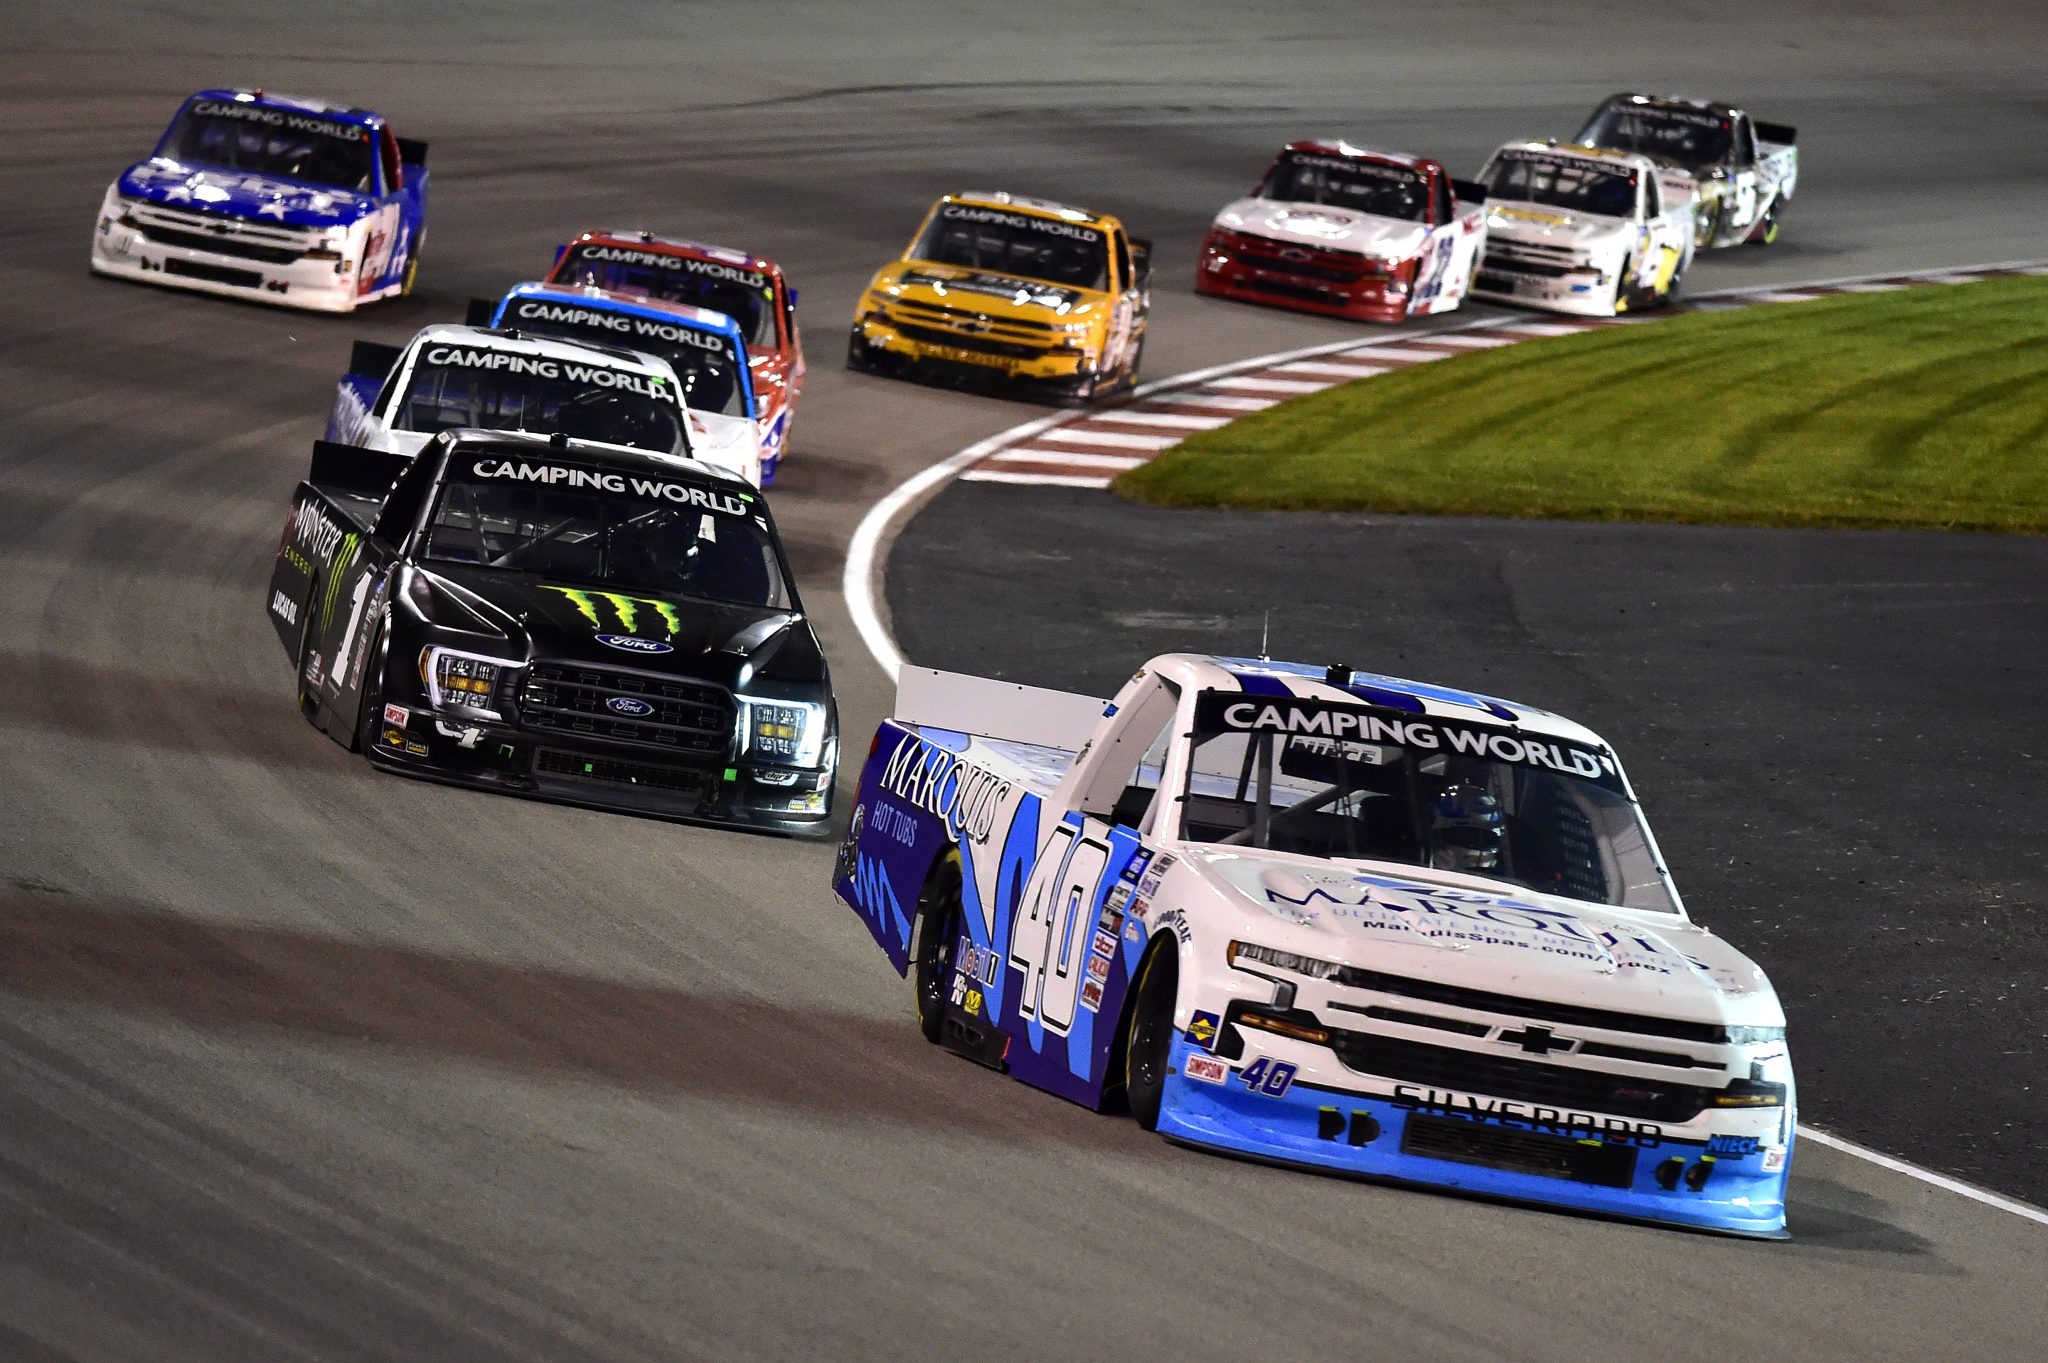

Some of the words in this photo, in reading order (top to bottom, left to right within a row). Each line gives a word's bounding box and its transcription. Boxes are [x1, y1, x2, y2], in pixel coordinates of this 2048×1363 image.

[194, 102, 286, 126] CAMPING
[287, 116, 361, 142] WORLD
[943, 206, 1027, 229] CAMPING
[1031, 219, 1098, 243] WORLD
[582, 246, 682, 271] CAMPING
[685, 260, 765, 288] WORLD
[518, 303, 631, 332] CAMPING
[636, 316, 723, 352] WORLD
[428, 347, 561, 379] CAMPING
[565, 363, 666, 400] WORLD
[473, 459, 625, 493] CAMPING
[630, 477, 747, 516] WORLD
[293, 498, 343, 569] MONSTER
[331, 569, 374, 689] 1
[610, 635, 659, 651] Ford
[615, 699, 642, 714] Ford
[1223, 703, 1440, 749] CAMPING
[1441, 726, 1602, 779] WORLD
[879, 733, 1012, 845] MARQUIS
[870, 800, 895, 831] HOT
[893, 809, 919, 848] TUBS
[1009, 820, 1113, 1038] 40
[1363, 920, 1671, 974] MaruisSpas.com/truex
[1238, 1055, 1299, 1099] 40
[1391, 1084, 1662, 1149] SILVERADO
